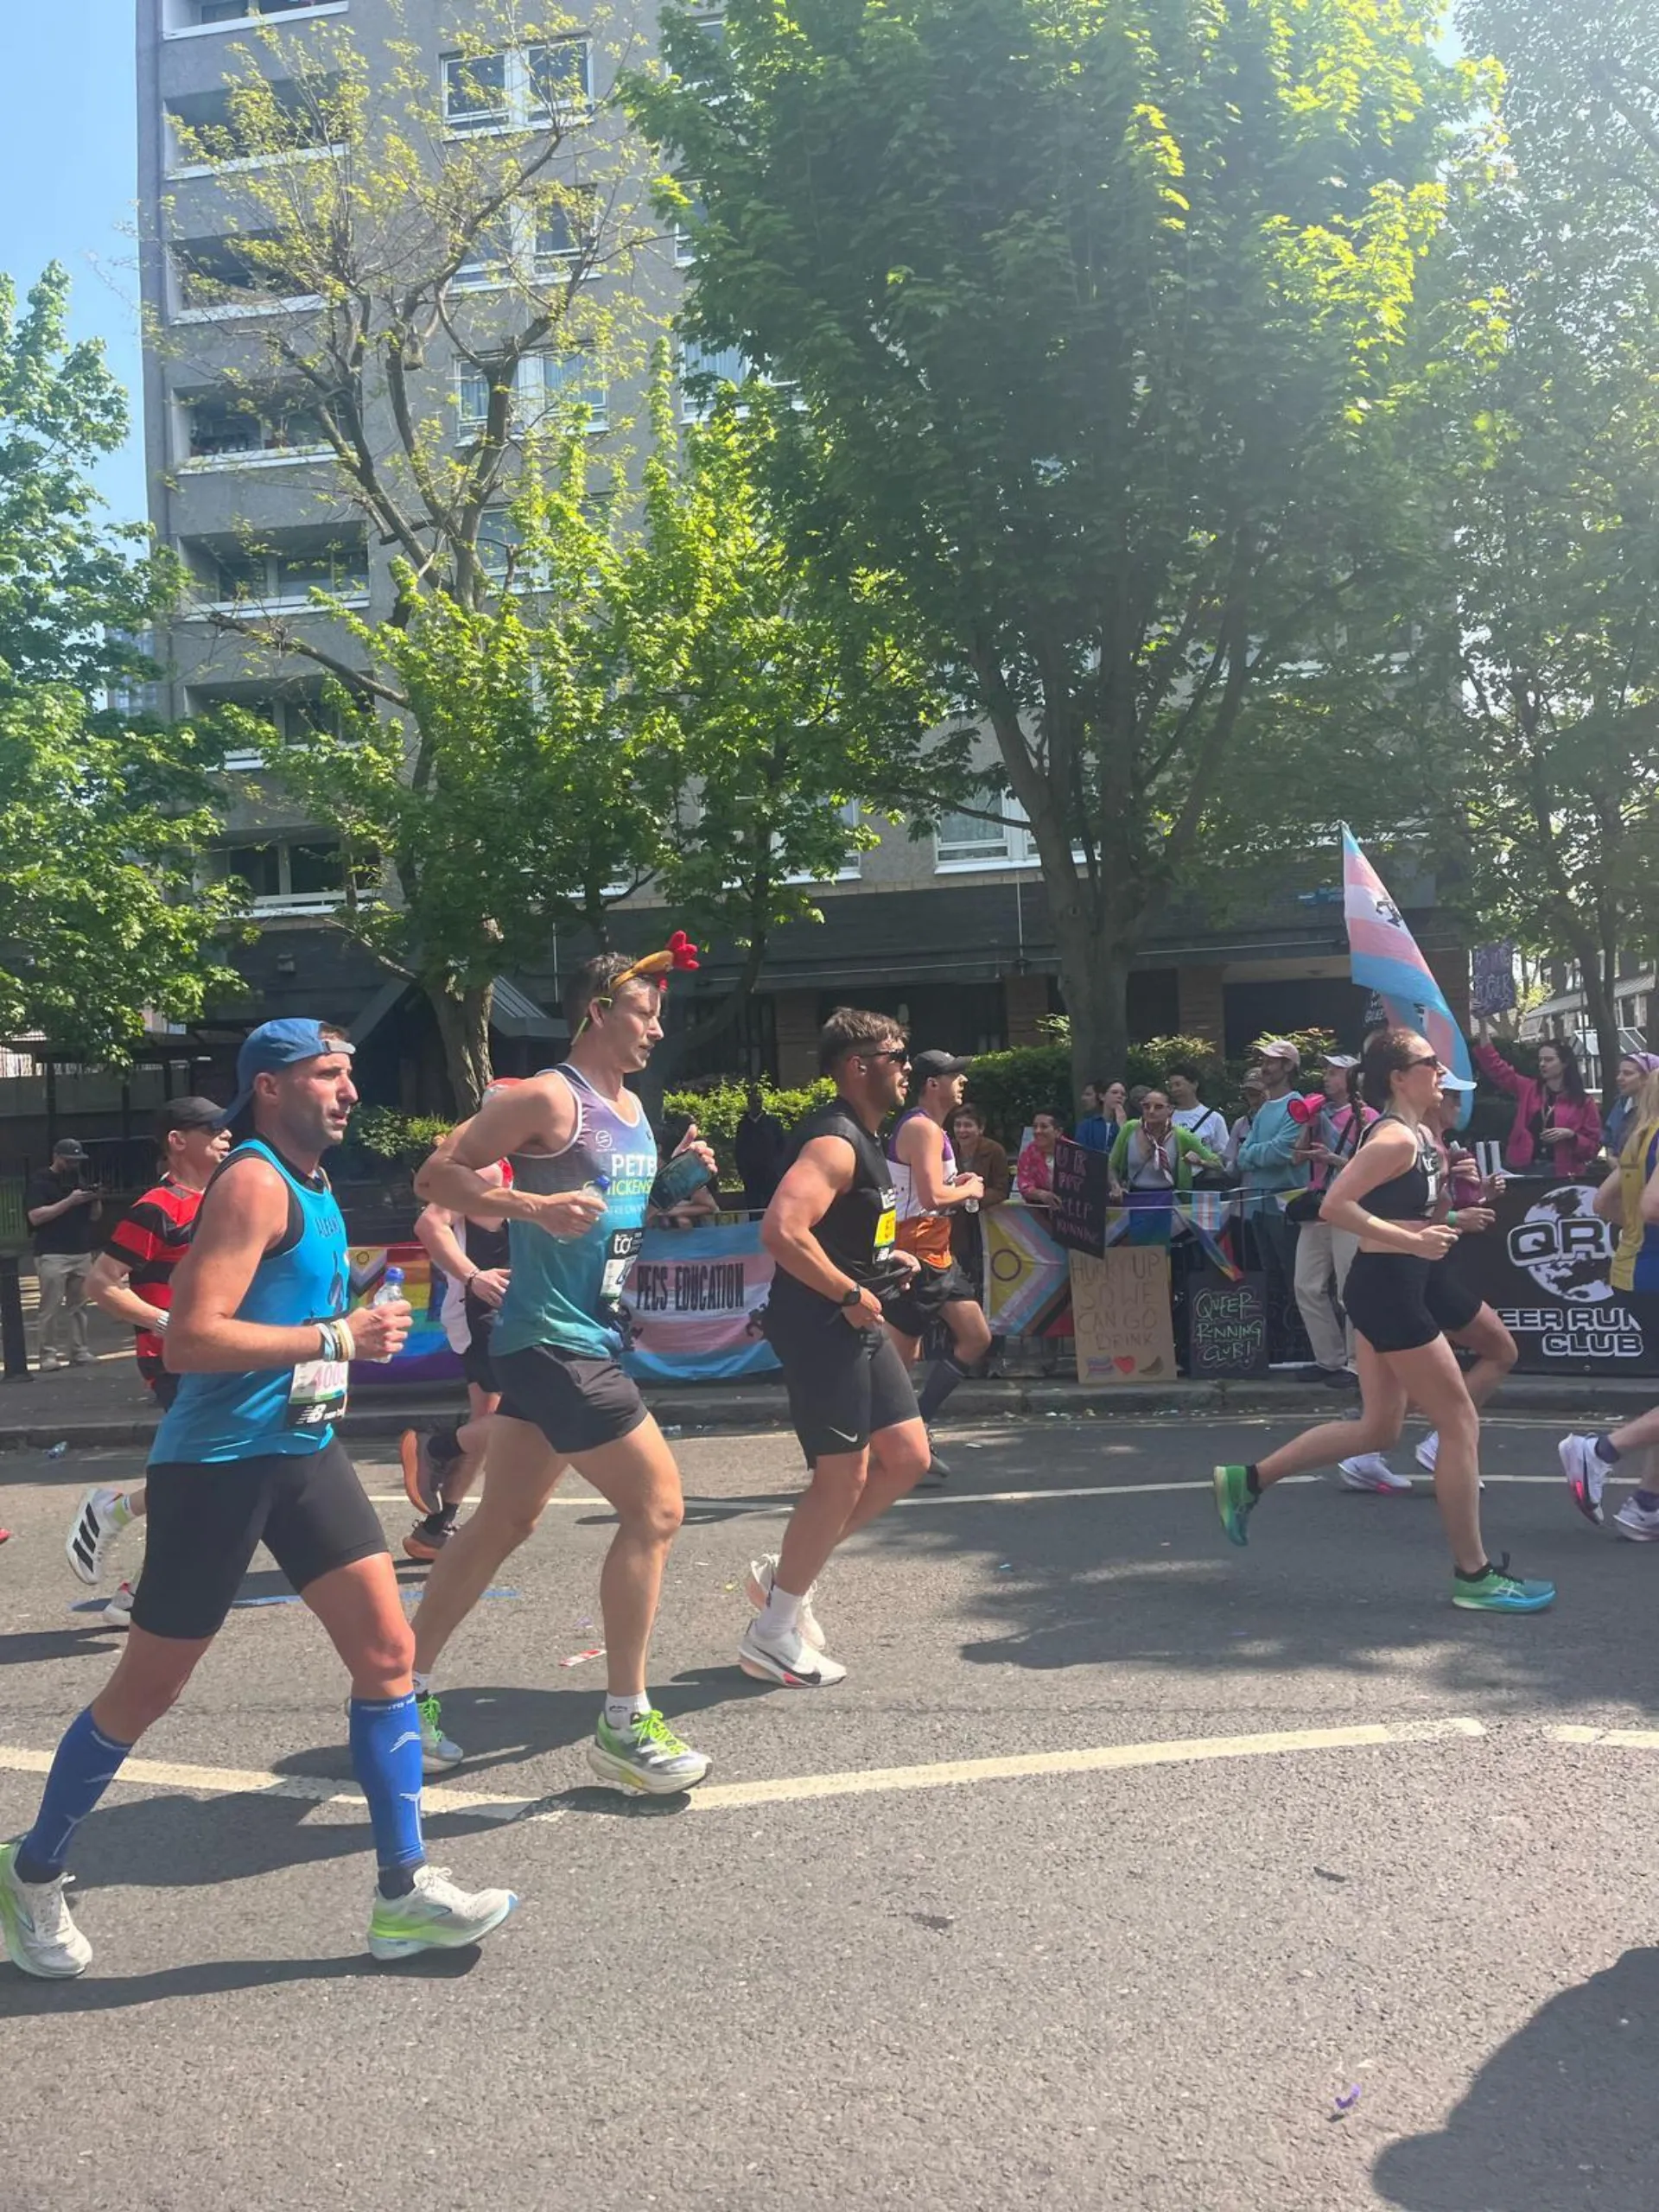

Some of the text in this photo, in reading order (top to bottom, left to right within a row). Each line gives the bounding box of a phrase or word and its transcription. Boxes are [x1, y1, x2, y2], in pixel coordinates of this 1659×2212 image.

[1056, 1145, 1088, 1177] U R
[1133, 1253, 1160, 1280] UP
[637, 1264, 669, 1312] PECS
[675, 1262, 745, 1312] EDUCATION
[1080, 1280, 1158, 1310] SO WE
[1077, 1306, 1159, 1335] CAN GO
[1195, 1291, 1261, 1322] QUEER
[1494, 1307, 1564, 1332] EER
[1096, 1331, 1154, 1351] DRINK
[1203, 1340, 1252, 1364] CLUB!
[1542, 1333, 1643, 1357] CLUB
